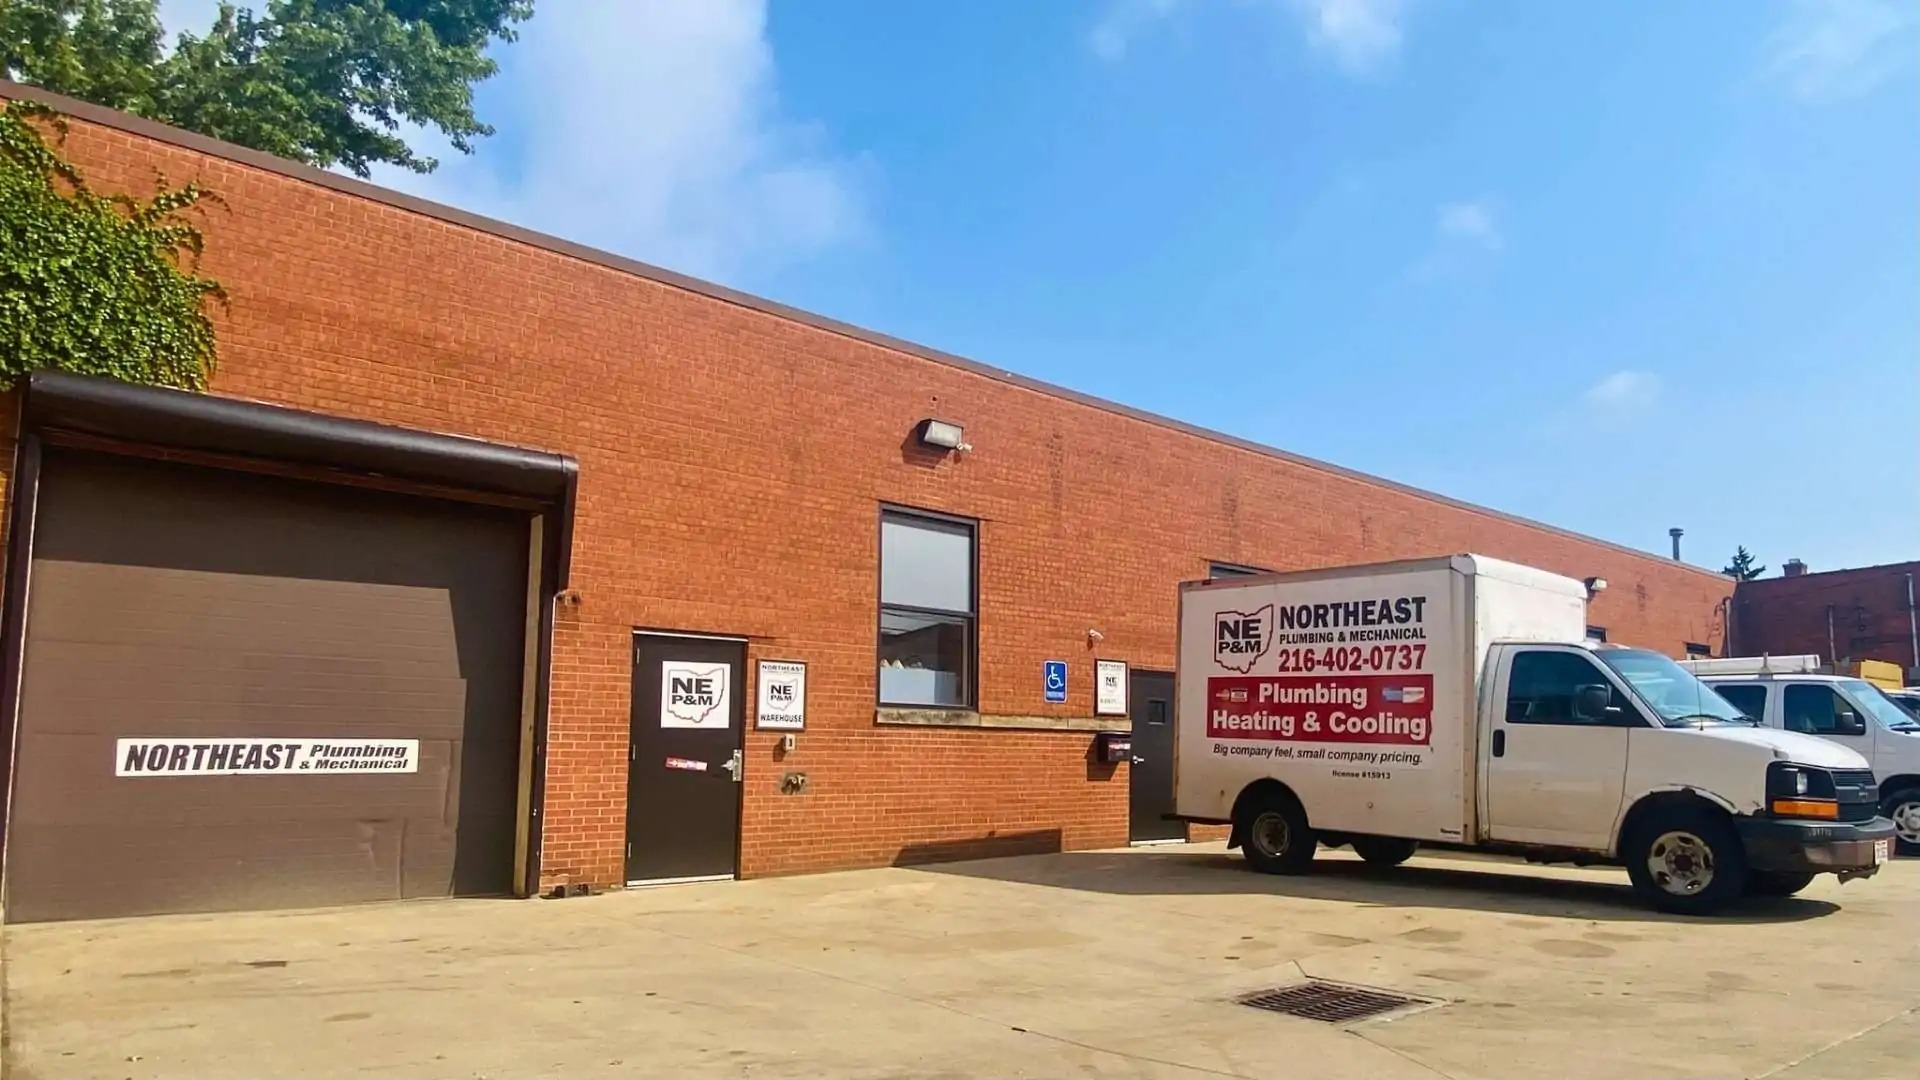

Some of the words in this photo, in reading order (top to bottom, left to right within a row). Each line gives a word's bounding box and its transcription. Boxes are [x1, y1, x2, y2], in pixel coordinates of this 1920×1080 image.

[1279, 596, 1426, 630] NORTHEAST
[1218, 618, 1261, 641] NE
[1279, 632, 1334, 645] PLUMBING
[1337, 631, 1346, 643] &
[1349, 627, 1426, 642] MECHANICAL
[1218, 640, 1261, 654] P&M
[1278, 643, 1427, 673] 216-402-0737
[671, 677, 713, 695] NE
[770, 684, 793, 695] NE
[671, 695, 713, 706] P&M
[1258, 682, 1368, 710] Plumbing
[760, 714, 802, 723] WAREHOUSE
[1212, 710, 1295, 737] Heating
[1303, 711, 1321, 733] &
[1329, 711, 1427, 740] Cooling
[124, 743, 301, 772] NORTHEAST
[309, 744, 408, 759] Plumbing
[1213, 743, 1229, 756] Big
[1230, 746, 1273, 760] company
[1274, 746, 1295, 760] feel,
[1296, 747, 1326, 760] small
[1327, 751, 1377, 765] company
[1379, 751, 1424, 766] pricing.
[299, 759, 310, 769] &
[314, 758, 408, 770] Mechanical
[1332, 769, 1360, 778] license
